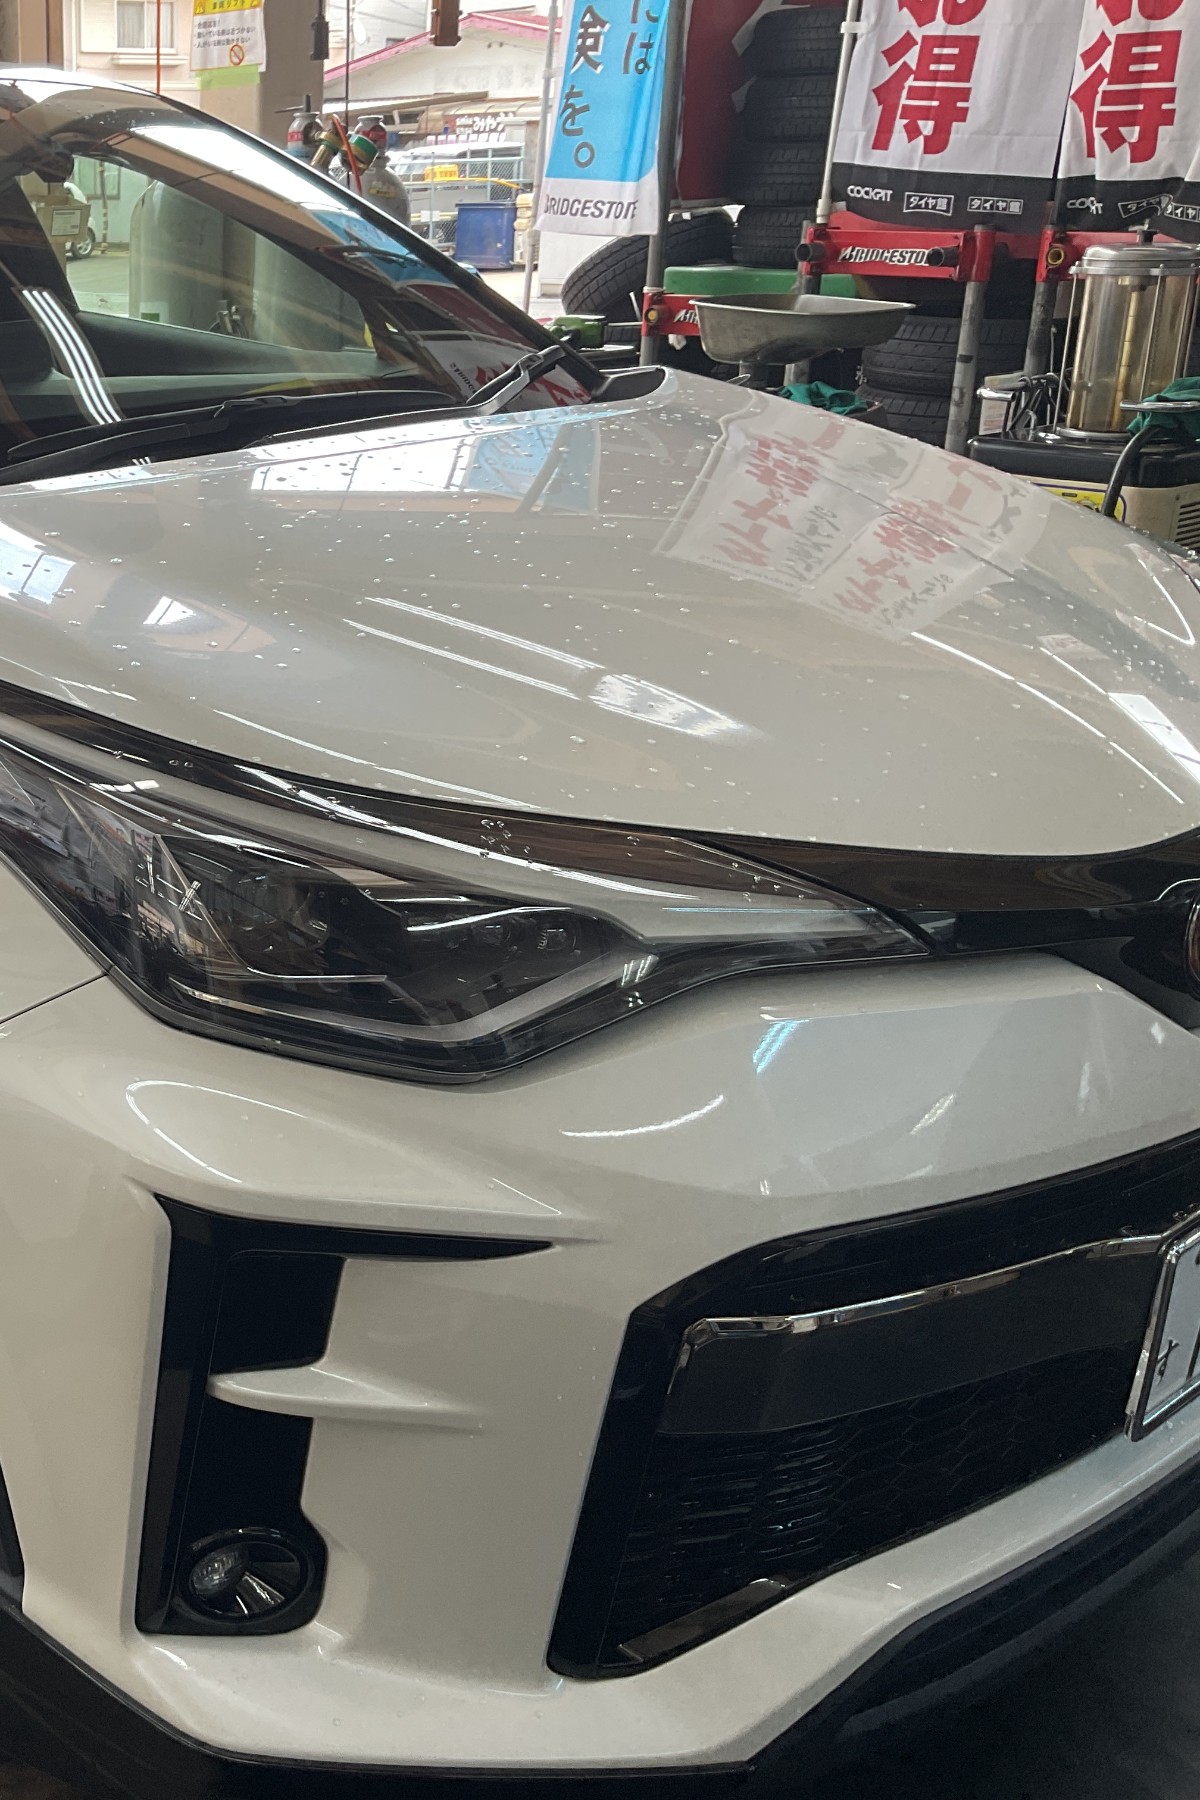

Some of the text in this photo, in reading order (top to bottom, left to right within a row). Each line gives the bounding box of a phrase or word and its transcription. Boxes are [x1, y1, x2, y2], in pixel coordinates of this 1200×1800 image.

[871, 0, 981, 155] 得
[1070, 0, 1183, 163] 得
[847, 185, 893, 202] COCKPIT
[908, 196, 949, 211] タイヤ館
[970, 198, 1021, 213] タイヤ館
[838, 246, 929, 266] BRIDGESTO
